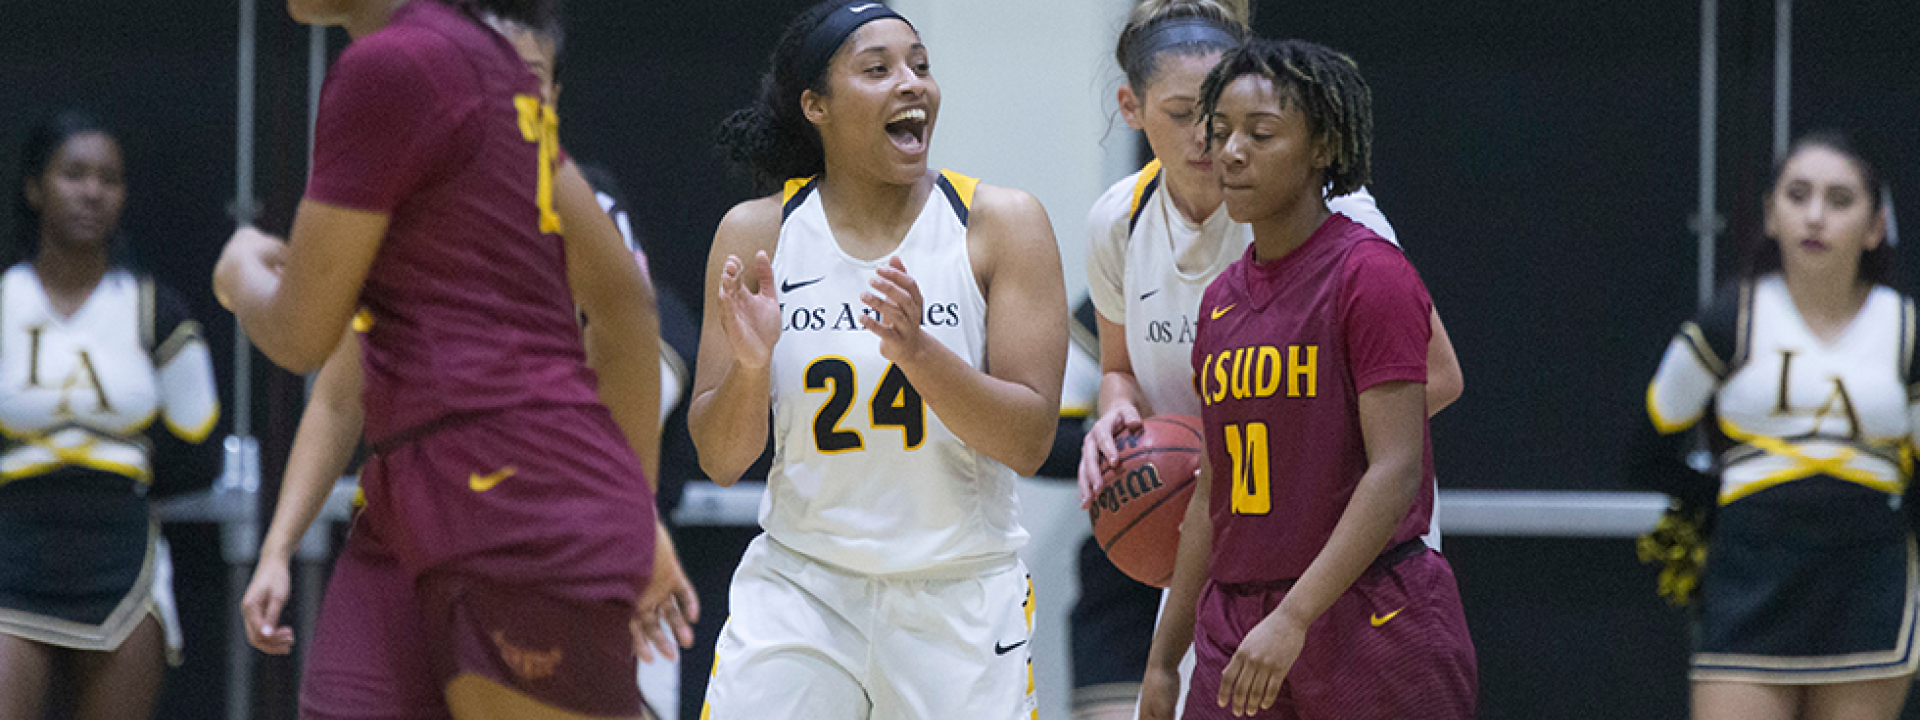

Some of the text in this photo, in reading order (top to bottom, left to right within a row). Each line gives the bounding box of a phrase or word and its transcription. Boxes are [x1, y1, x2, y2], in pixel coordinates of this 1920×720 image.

[1145, 320, 1173, 343] os
[802, 354, 927, 455] 24
[1200, 345, 1319, 405] CSUDH
[1223, 422, 1271, 514] 10
